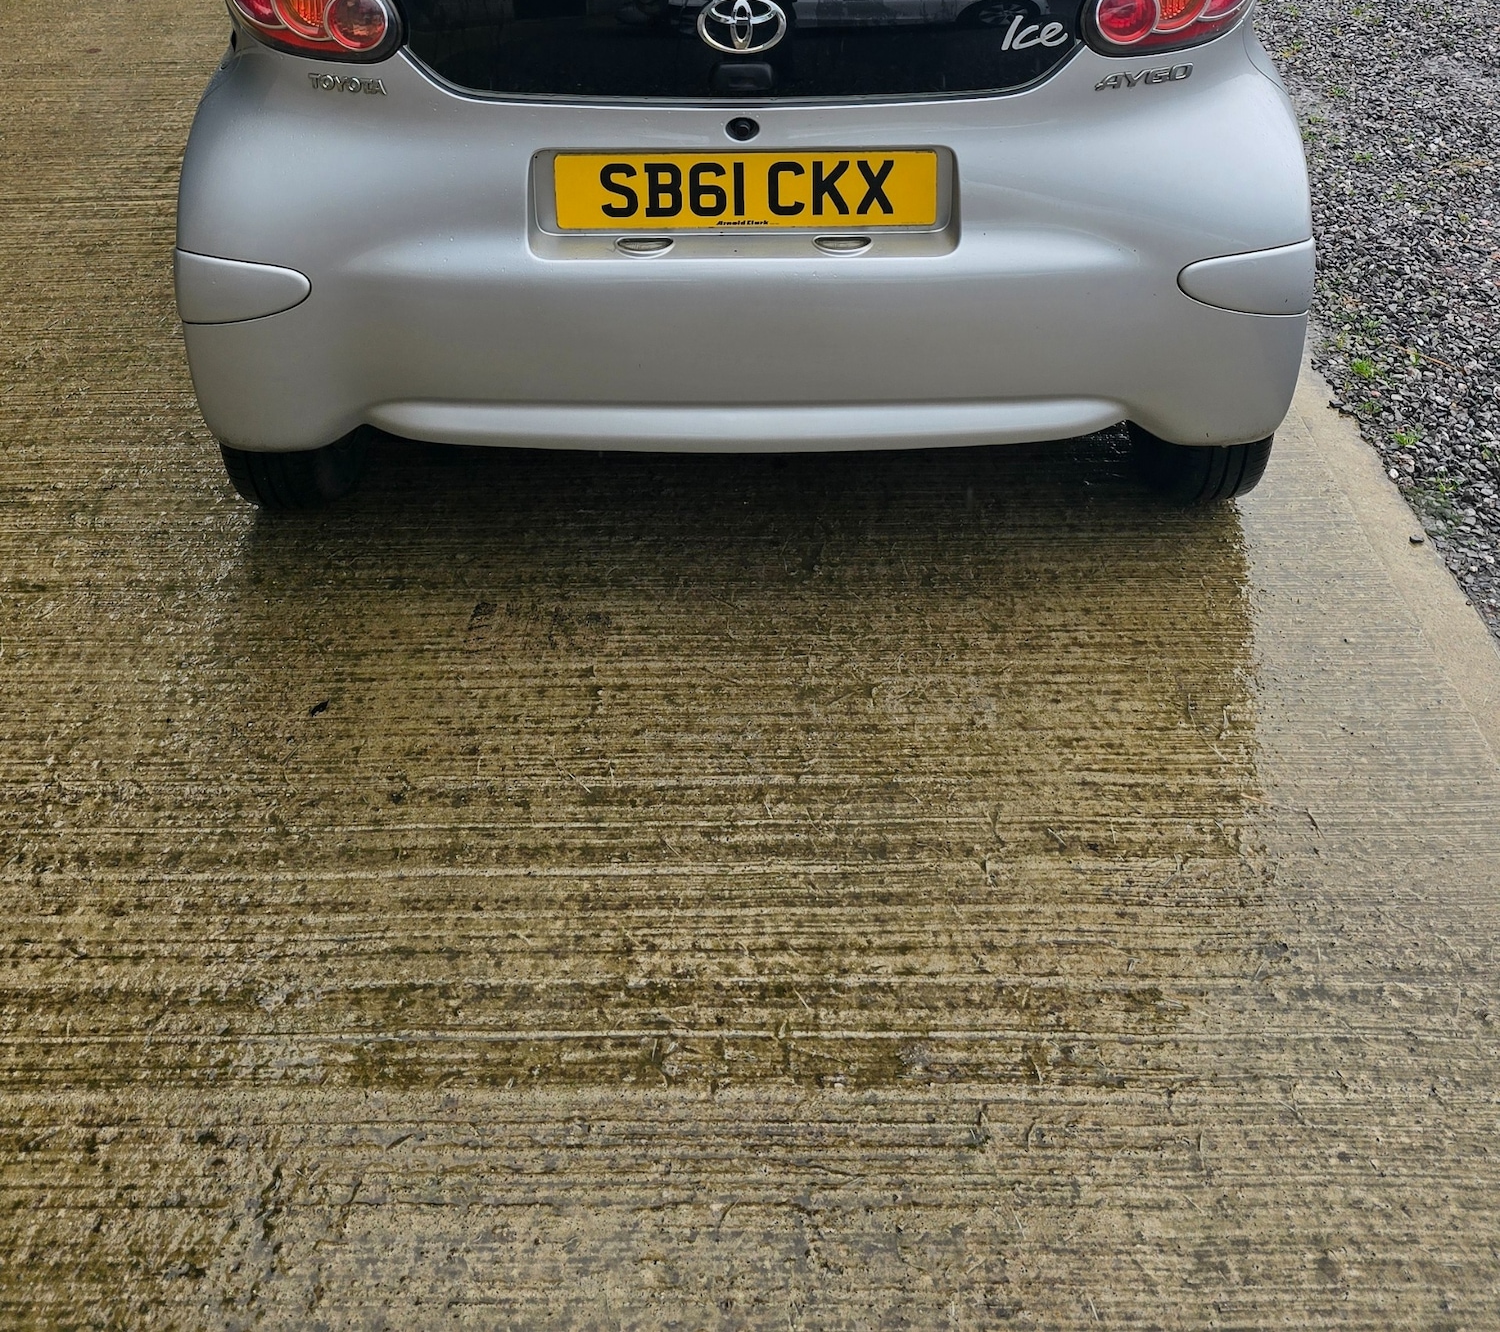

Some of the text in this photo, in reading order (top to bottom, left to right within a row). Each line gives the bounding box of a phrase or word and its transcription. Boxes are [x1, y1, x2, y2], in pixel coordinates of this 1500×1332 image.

[1001, 15, 1068, 50] Ice
[308, 73, 387, 95] TOYOTA
[1095, 62, 1193, 91] AYGO
[600, 160, 894, 217] SB61 CKX
